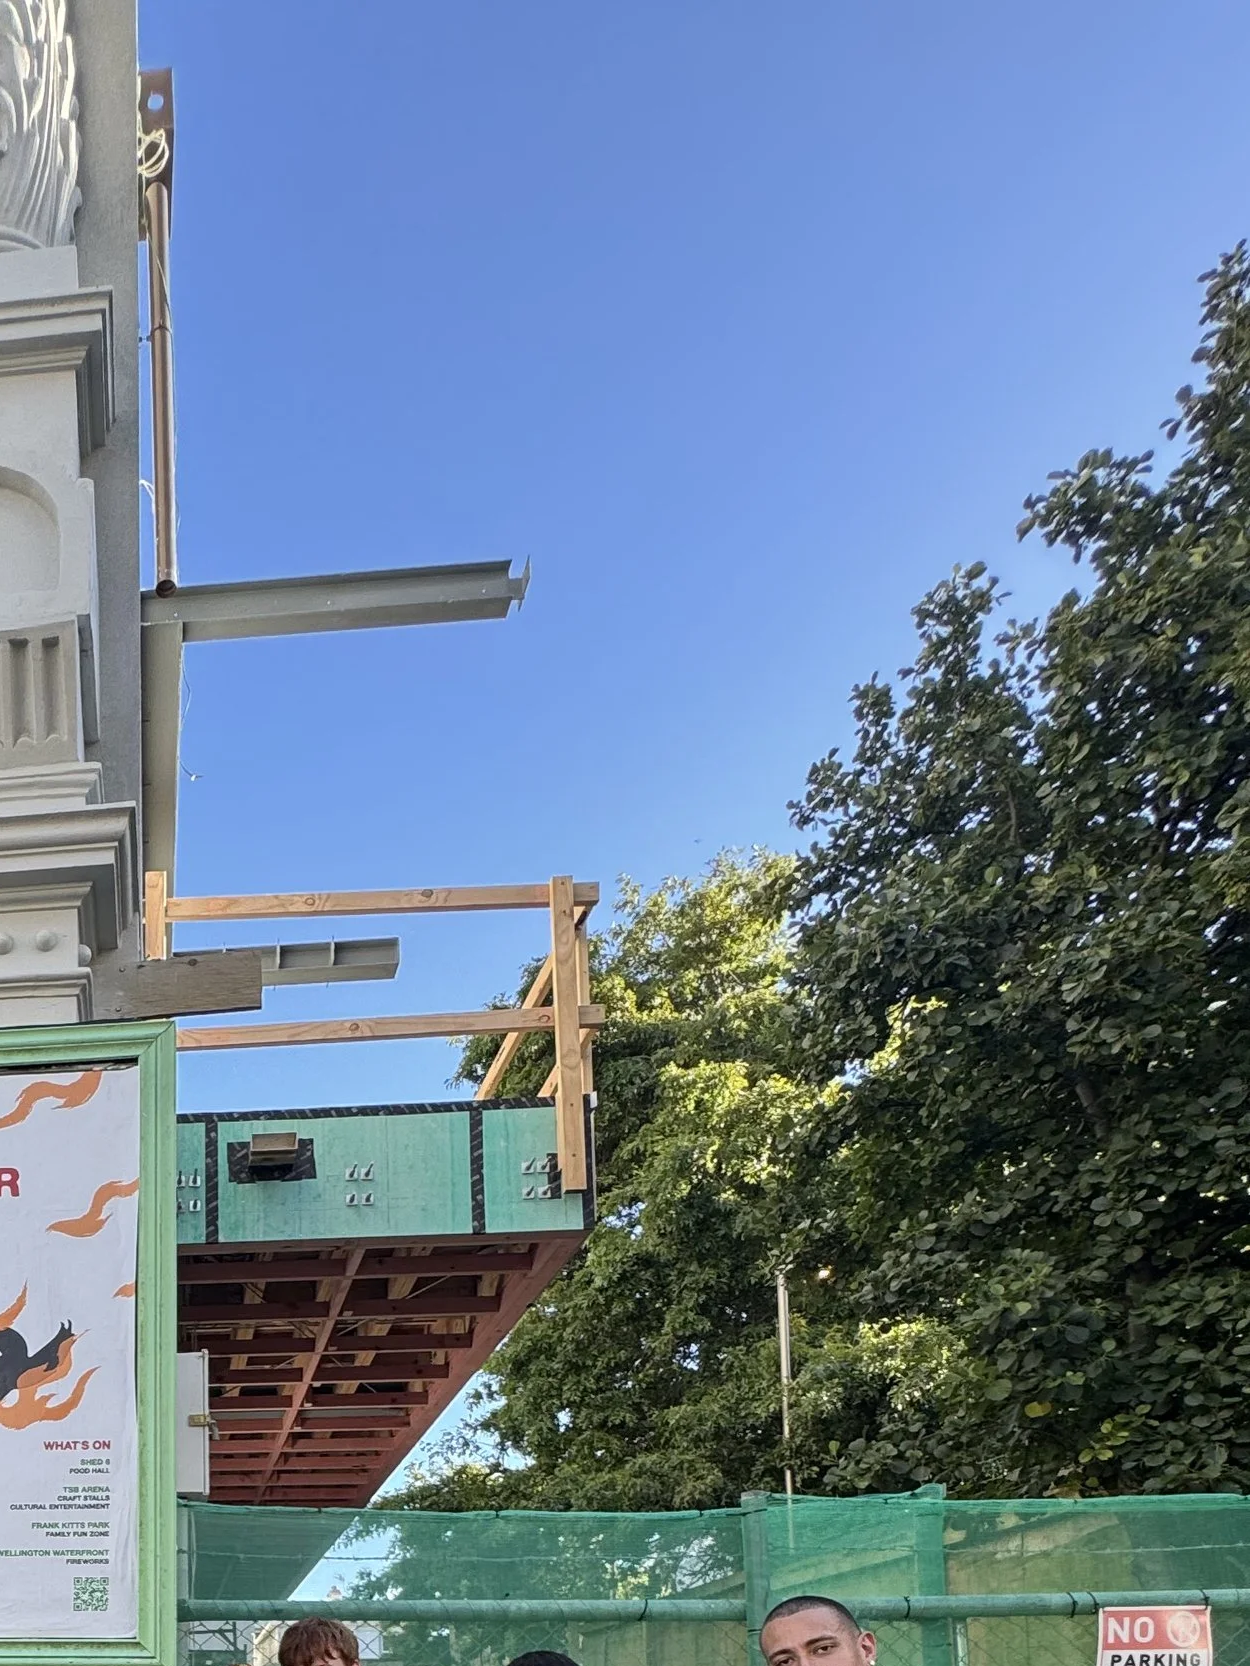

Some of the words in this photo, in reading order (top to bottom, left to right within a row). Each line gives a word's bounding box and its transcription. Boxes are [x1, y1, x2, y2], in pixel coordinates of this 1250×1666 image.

[44, 1440, 90, 1450] WHAT'S
[93, 1440, 111, 1450] ON
[1107, 1616, 1155, 1644] NO
